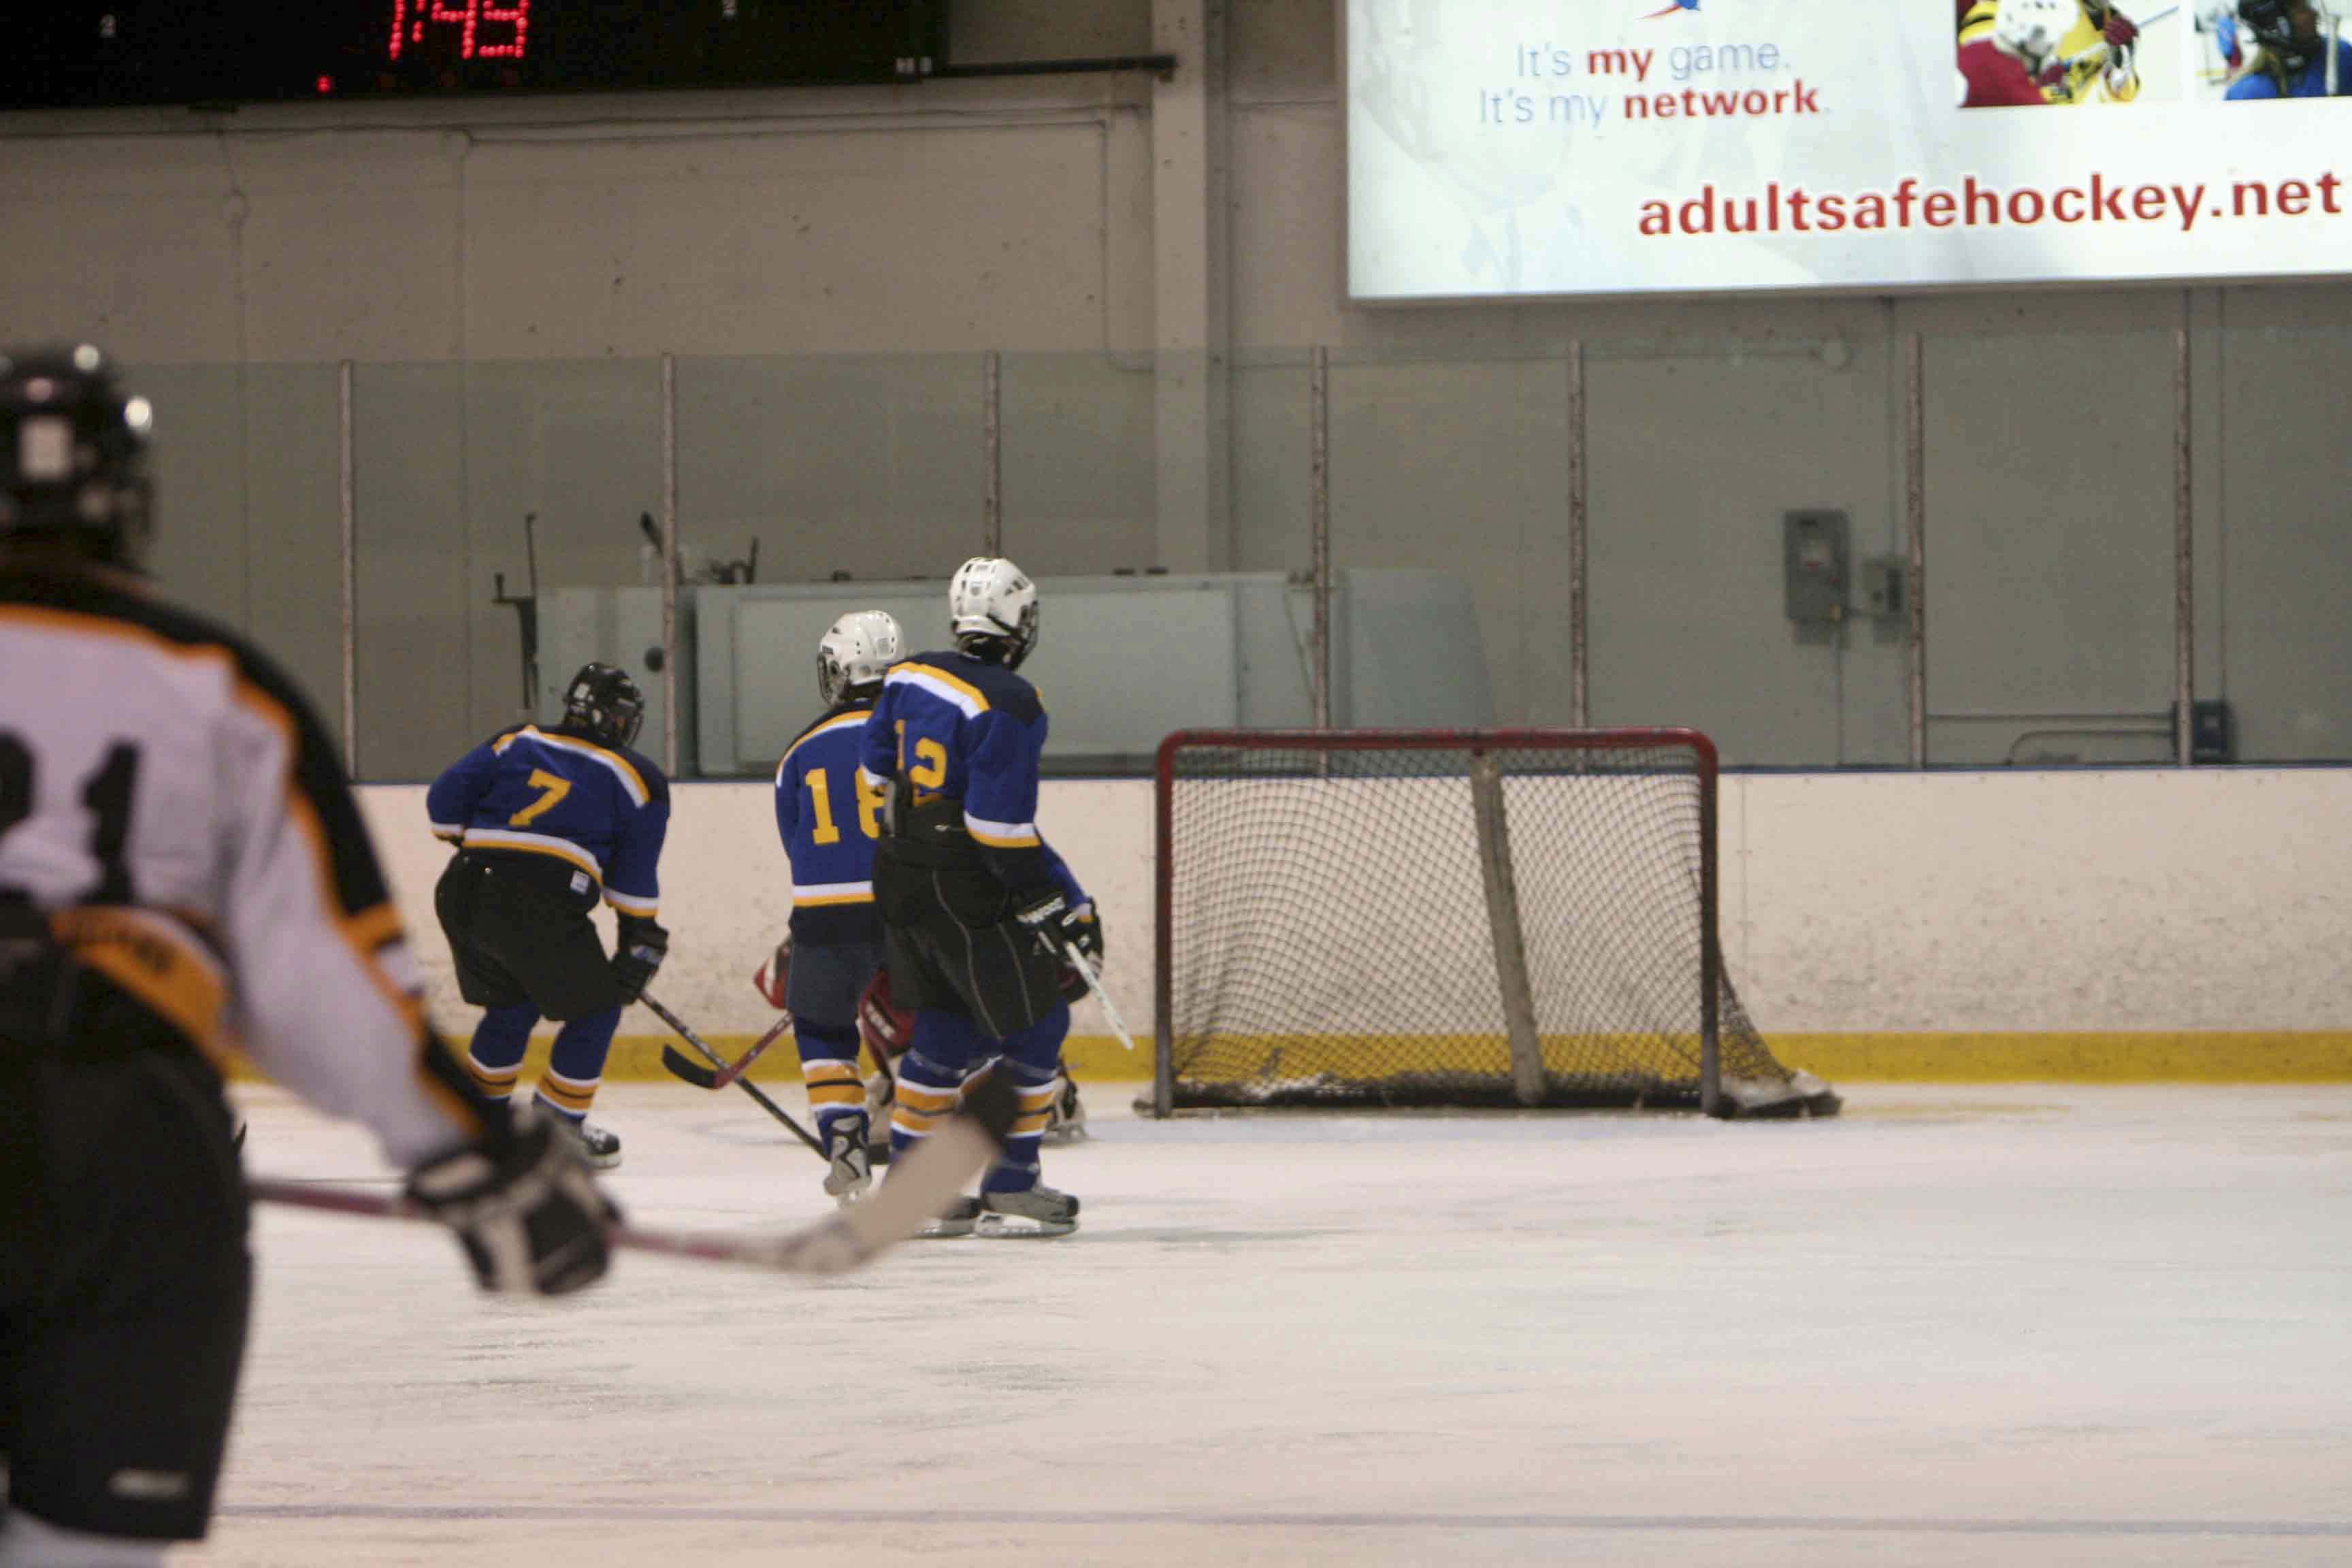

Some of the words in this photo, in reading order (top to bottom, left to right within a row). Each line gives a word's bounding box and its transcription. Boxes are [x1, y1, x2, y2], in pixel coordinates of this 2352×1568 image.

[1517, 42, 1571, 76] It's
[1586, 48, 1654, 82] my
[1669, 43, 1791, 81] game.
[1480, 87, 1533, 123] It's
[1548, 94, 1608, 129] my
[1638, 170, 2342, 235] adultsafehockey.net
[508, 768, 572, 827] 7
